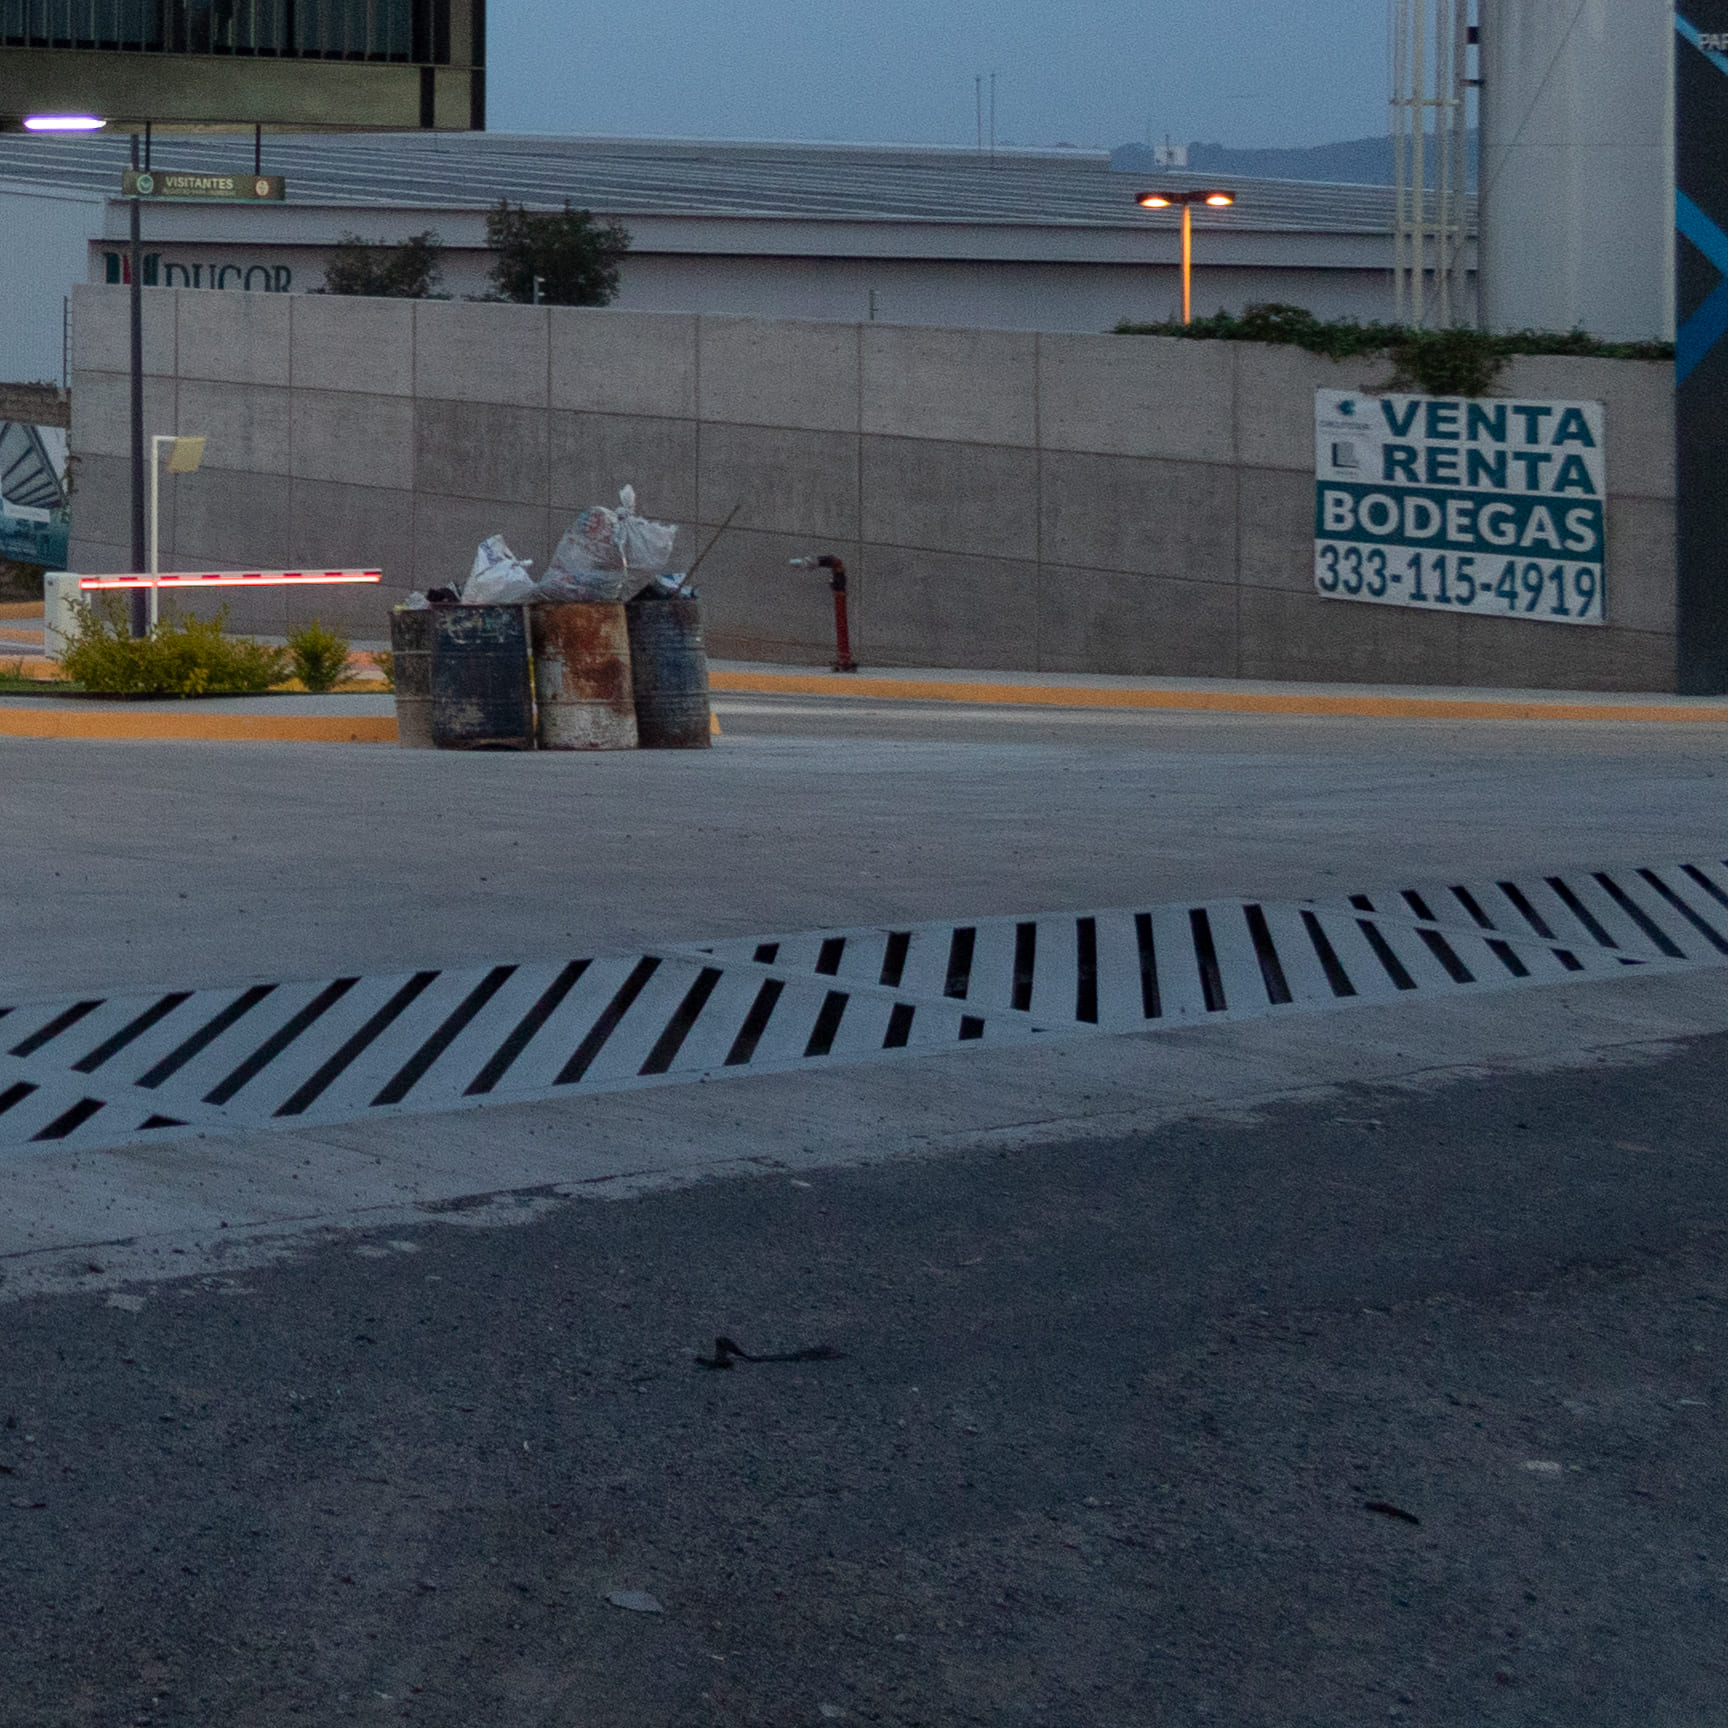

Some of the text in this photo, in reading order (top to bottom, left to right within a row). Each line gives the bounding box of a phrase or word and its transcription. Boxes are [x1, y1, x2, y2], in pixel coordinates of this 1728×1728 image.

[165, 176, 234, 190] VISITANTES
[1380, 399, 1597, 448] VENTA
[1382, 443, 1598, 495] RENTA
[1322, 489, 1597, 553] BODEGAS
[1318, 543, 1596, 618] 333-115-4919
